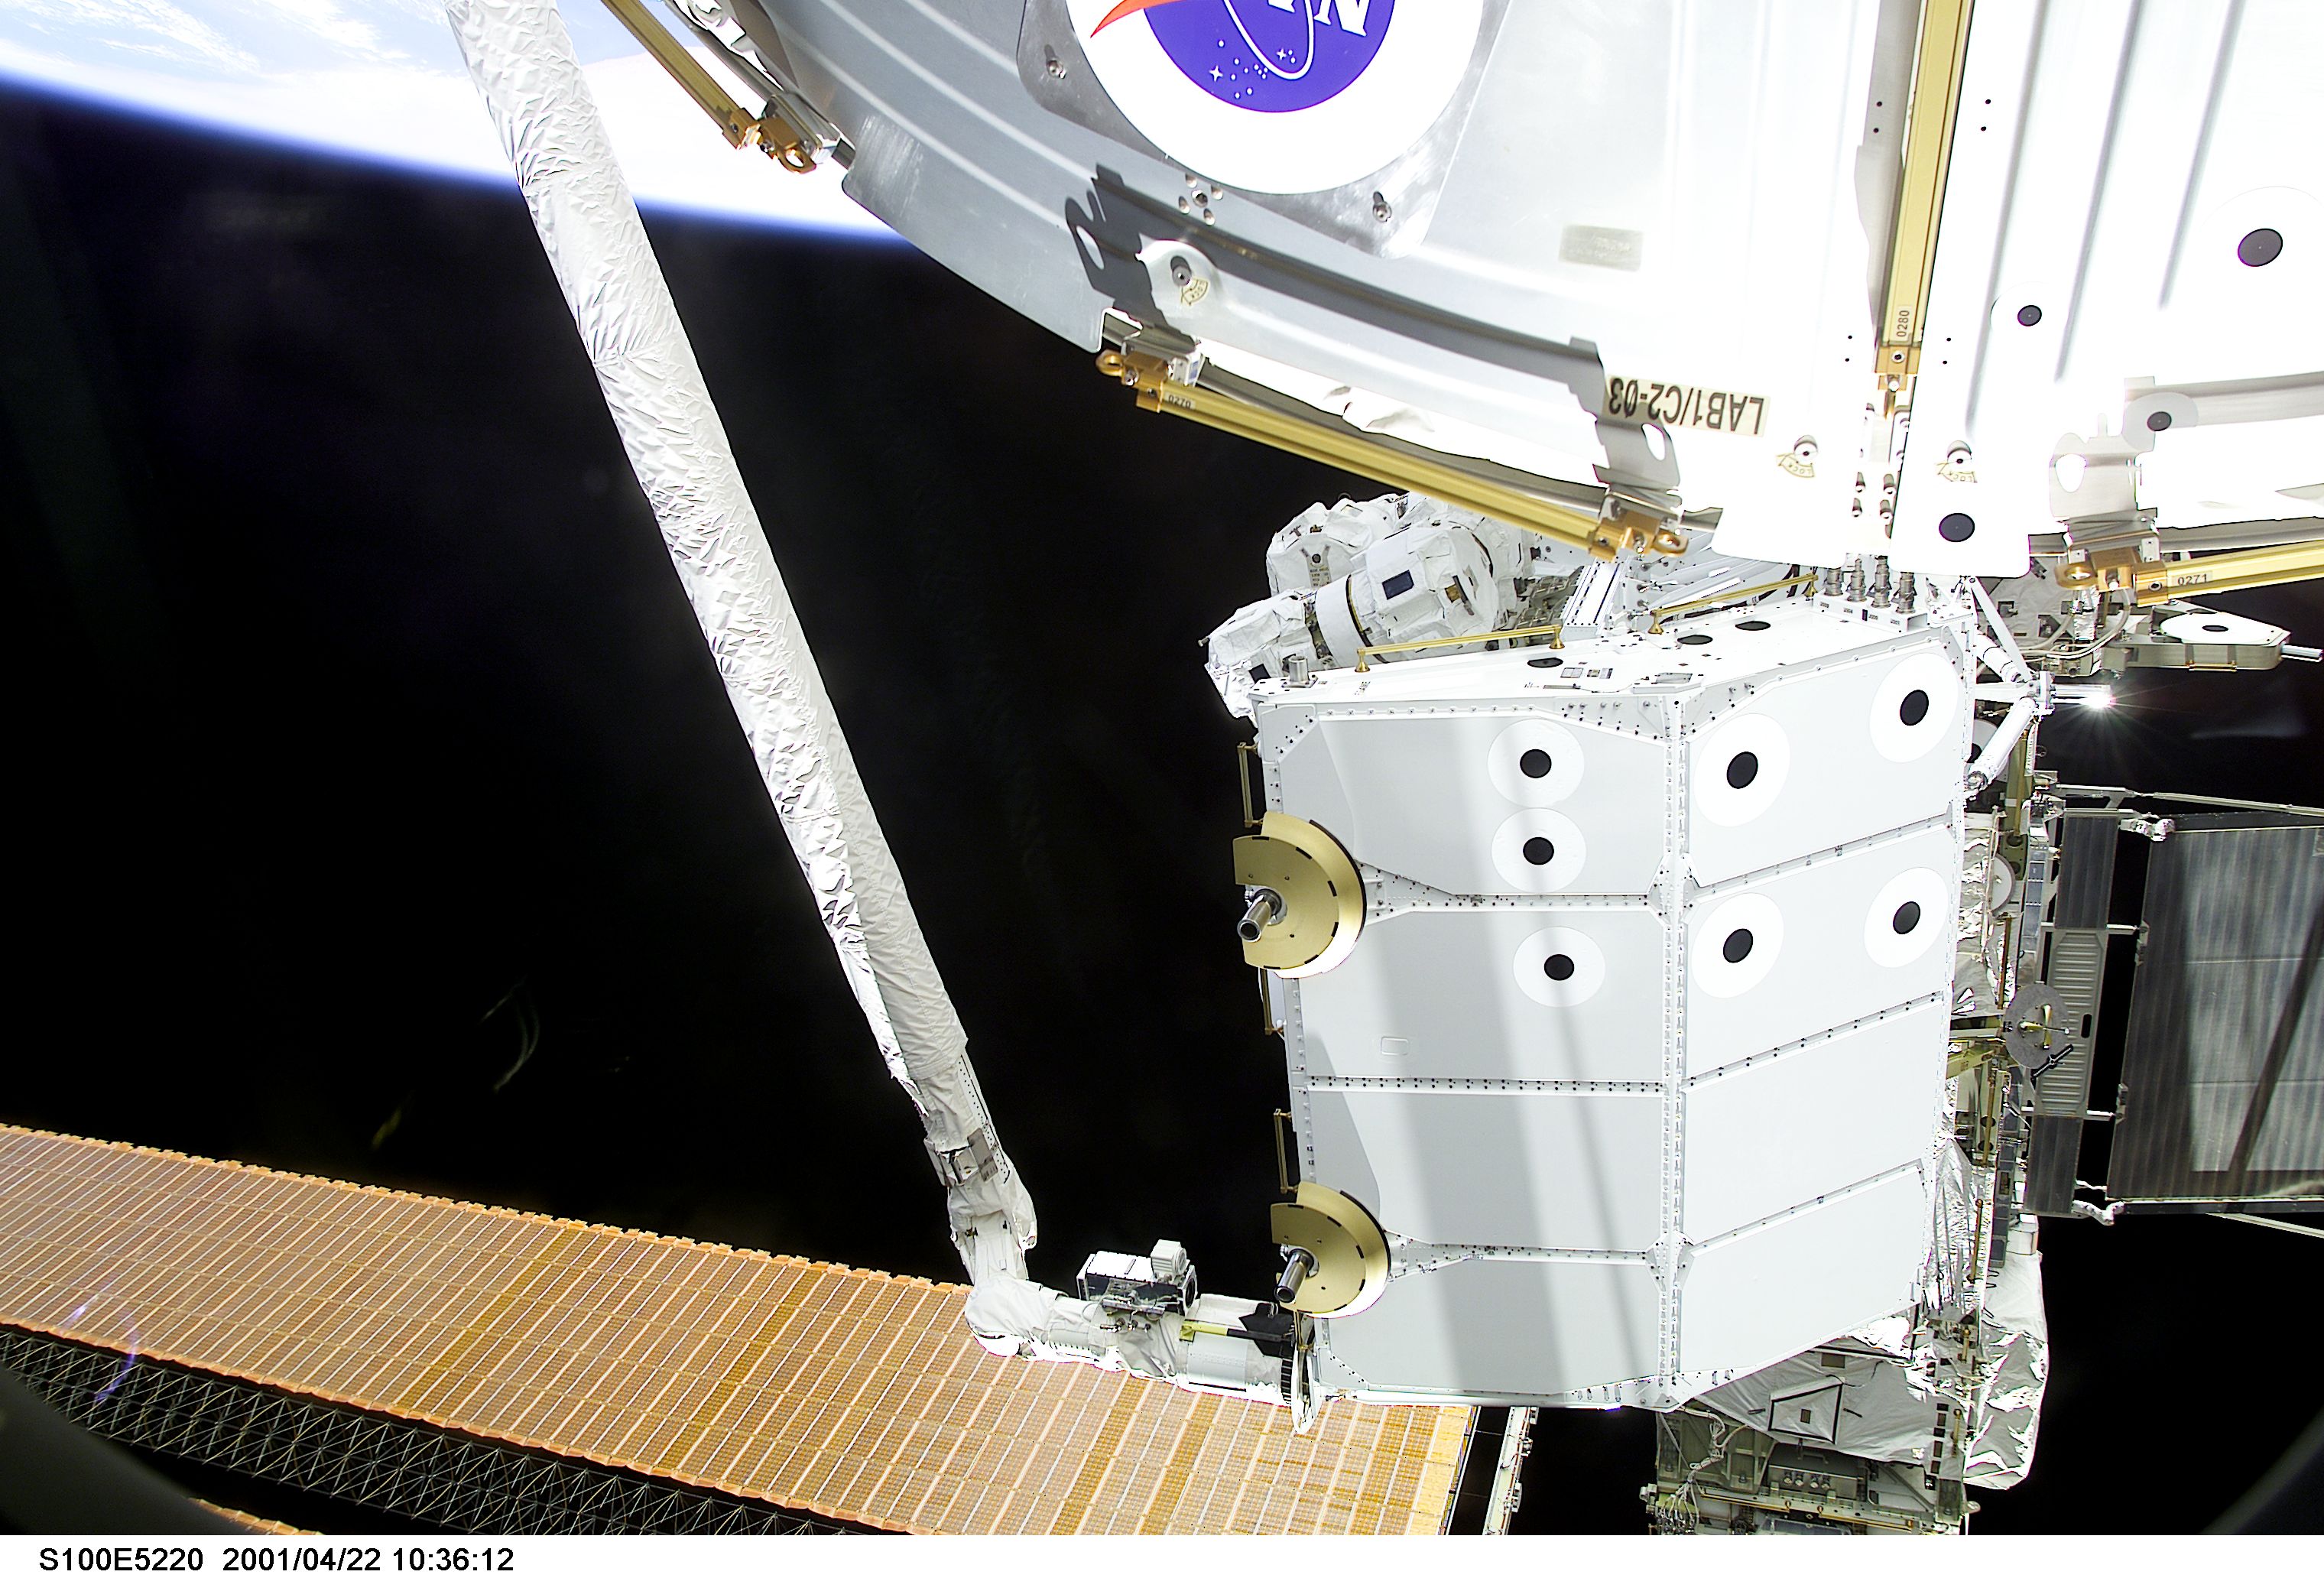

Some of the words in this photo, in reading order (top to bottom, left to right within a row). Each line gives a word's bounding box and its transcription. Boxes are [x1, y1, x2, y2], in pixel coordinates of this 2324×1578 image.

[1896, 310, 1910, 337] 0280
[1168, 394, 1191, 409] 0270
[1608, 378, 1764, 435] LAB1/C2-03
[2177, 574, 2208, 586] 0271
